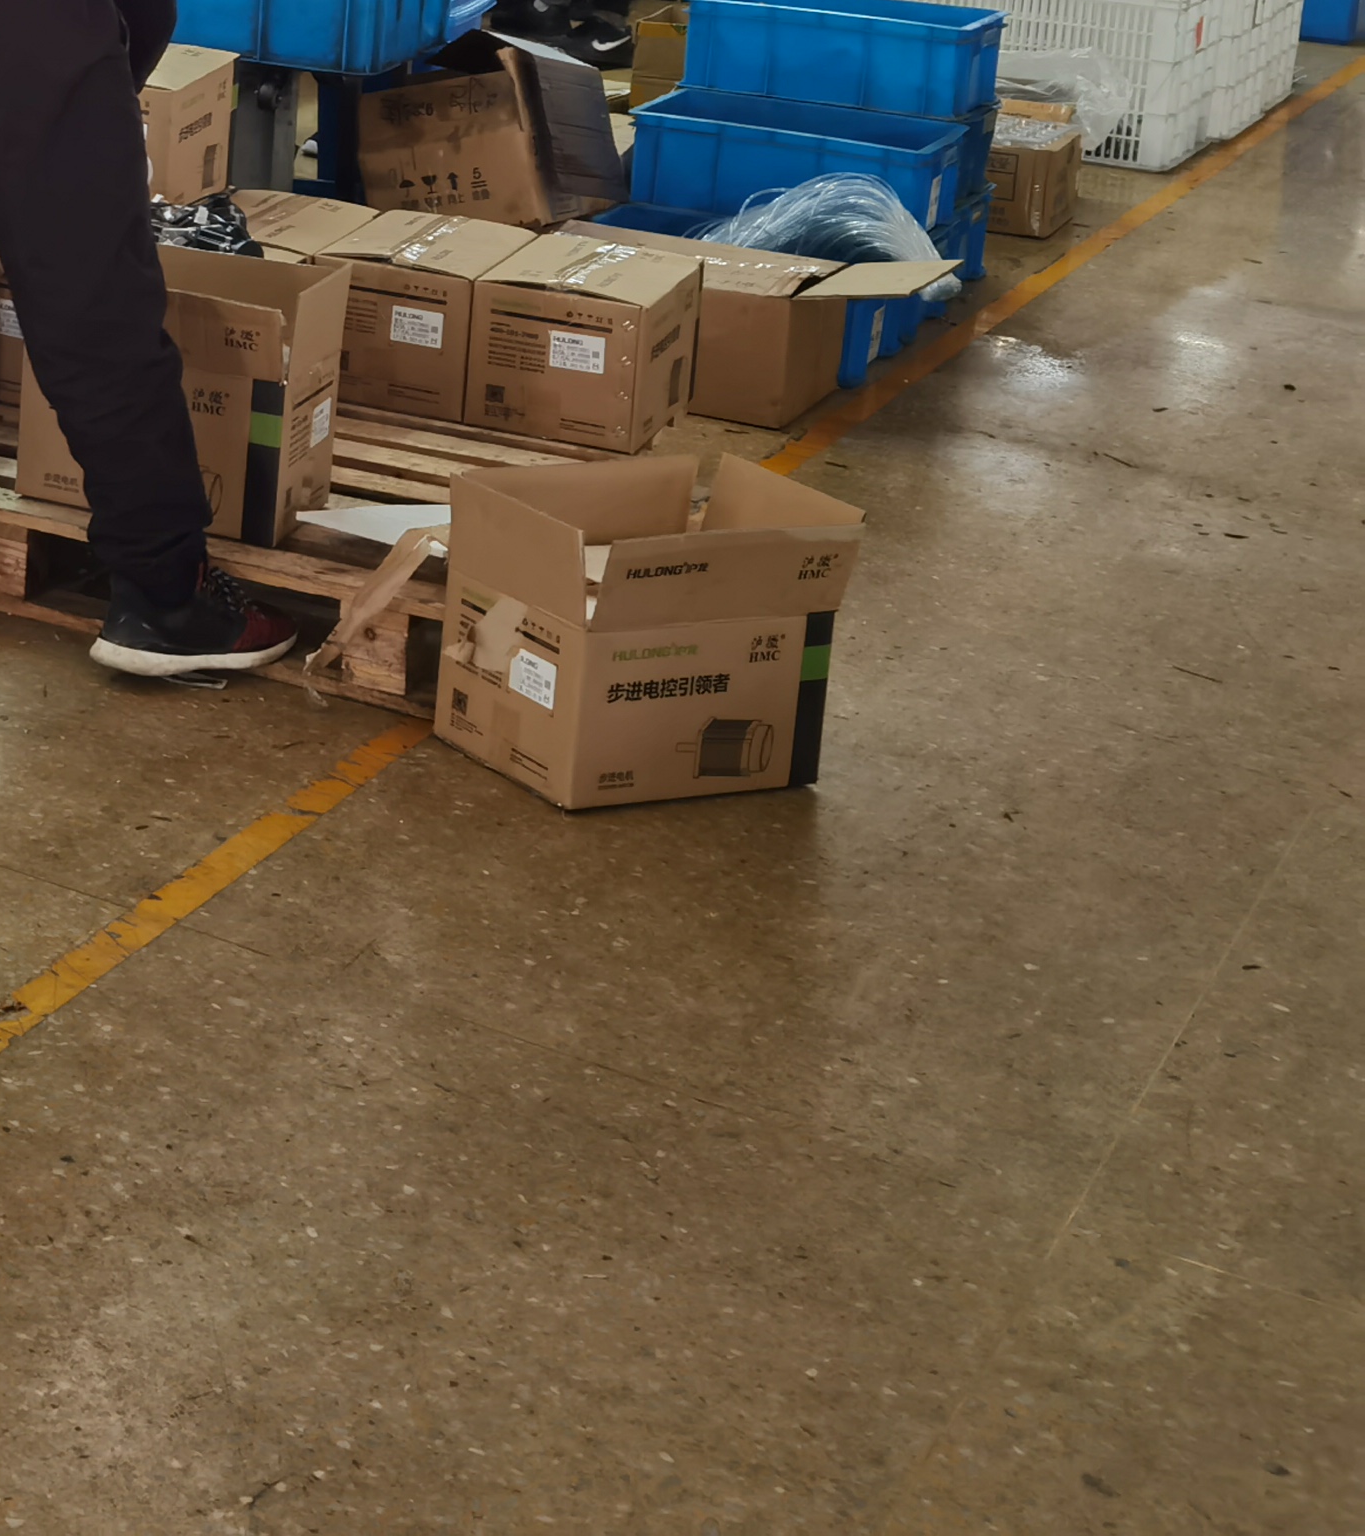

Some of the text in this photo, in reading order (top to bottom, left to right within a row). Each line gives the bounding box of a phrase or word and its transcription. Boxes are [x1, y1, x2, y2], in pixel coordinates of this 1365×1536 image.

[224, 337, 259, 352] HMC
[192, 402, 226, 416] HMC
[626, 565, 683, 579] HULONG
[798, 568, 831, 580] HMC
[612, 646, 672, 662] HULONG
[749, 650, 781, 663] HMC
[607, 673, 731, 704] 步进电控引领者
